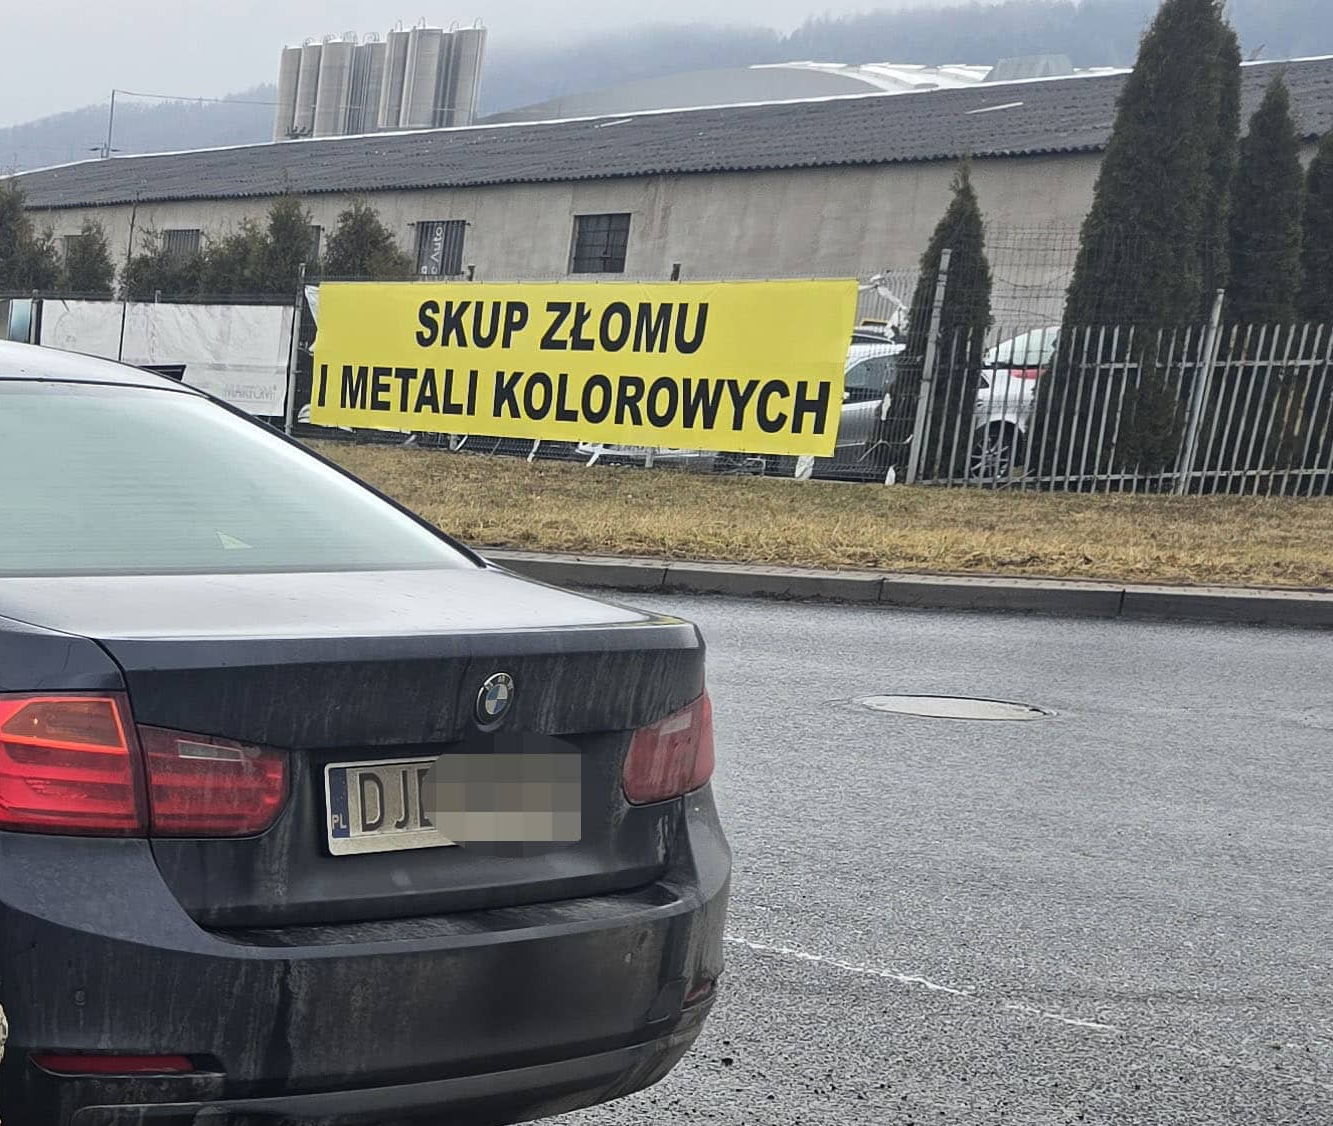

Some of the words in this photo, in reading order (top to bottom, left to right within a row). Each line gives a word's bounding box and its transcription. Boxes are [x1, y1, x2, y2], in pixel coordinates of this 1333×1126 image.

[415, 300, 529, 349] SKUP
[540, 301, 709, 354] ZŁOMU
[317, 364, 329, 407] I
[339, 365, 479, 416] METALI
[492, 370, 831, 435] KOLOROWYCH
[331, 813, 348, 830] PL
